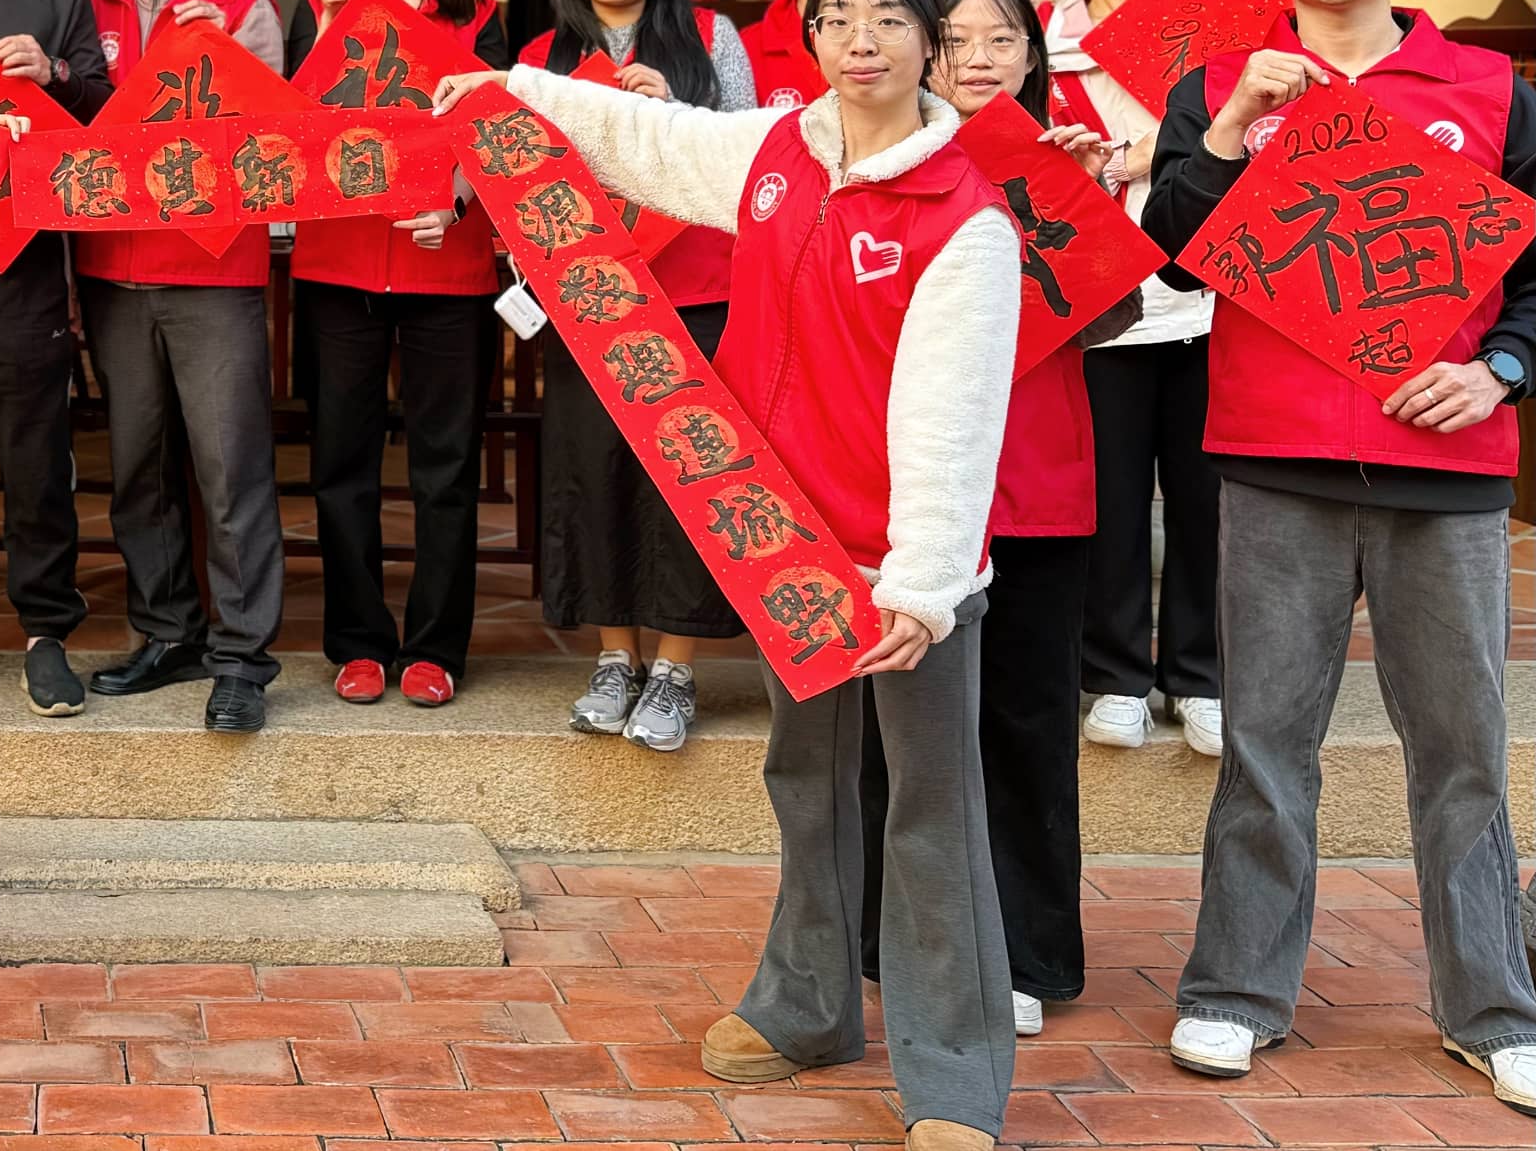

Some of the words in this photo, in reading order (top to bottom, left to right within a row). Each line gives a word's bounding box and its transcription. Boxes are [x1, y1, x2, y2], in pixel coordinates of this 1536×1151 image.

[1284, 104, 1389, 163] 2026
[1270, 162, 1471, 316] 福
[1347, 317, 1415, 376] 超
